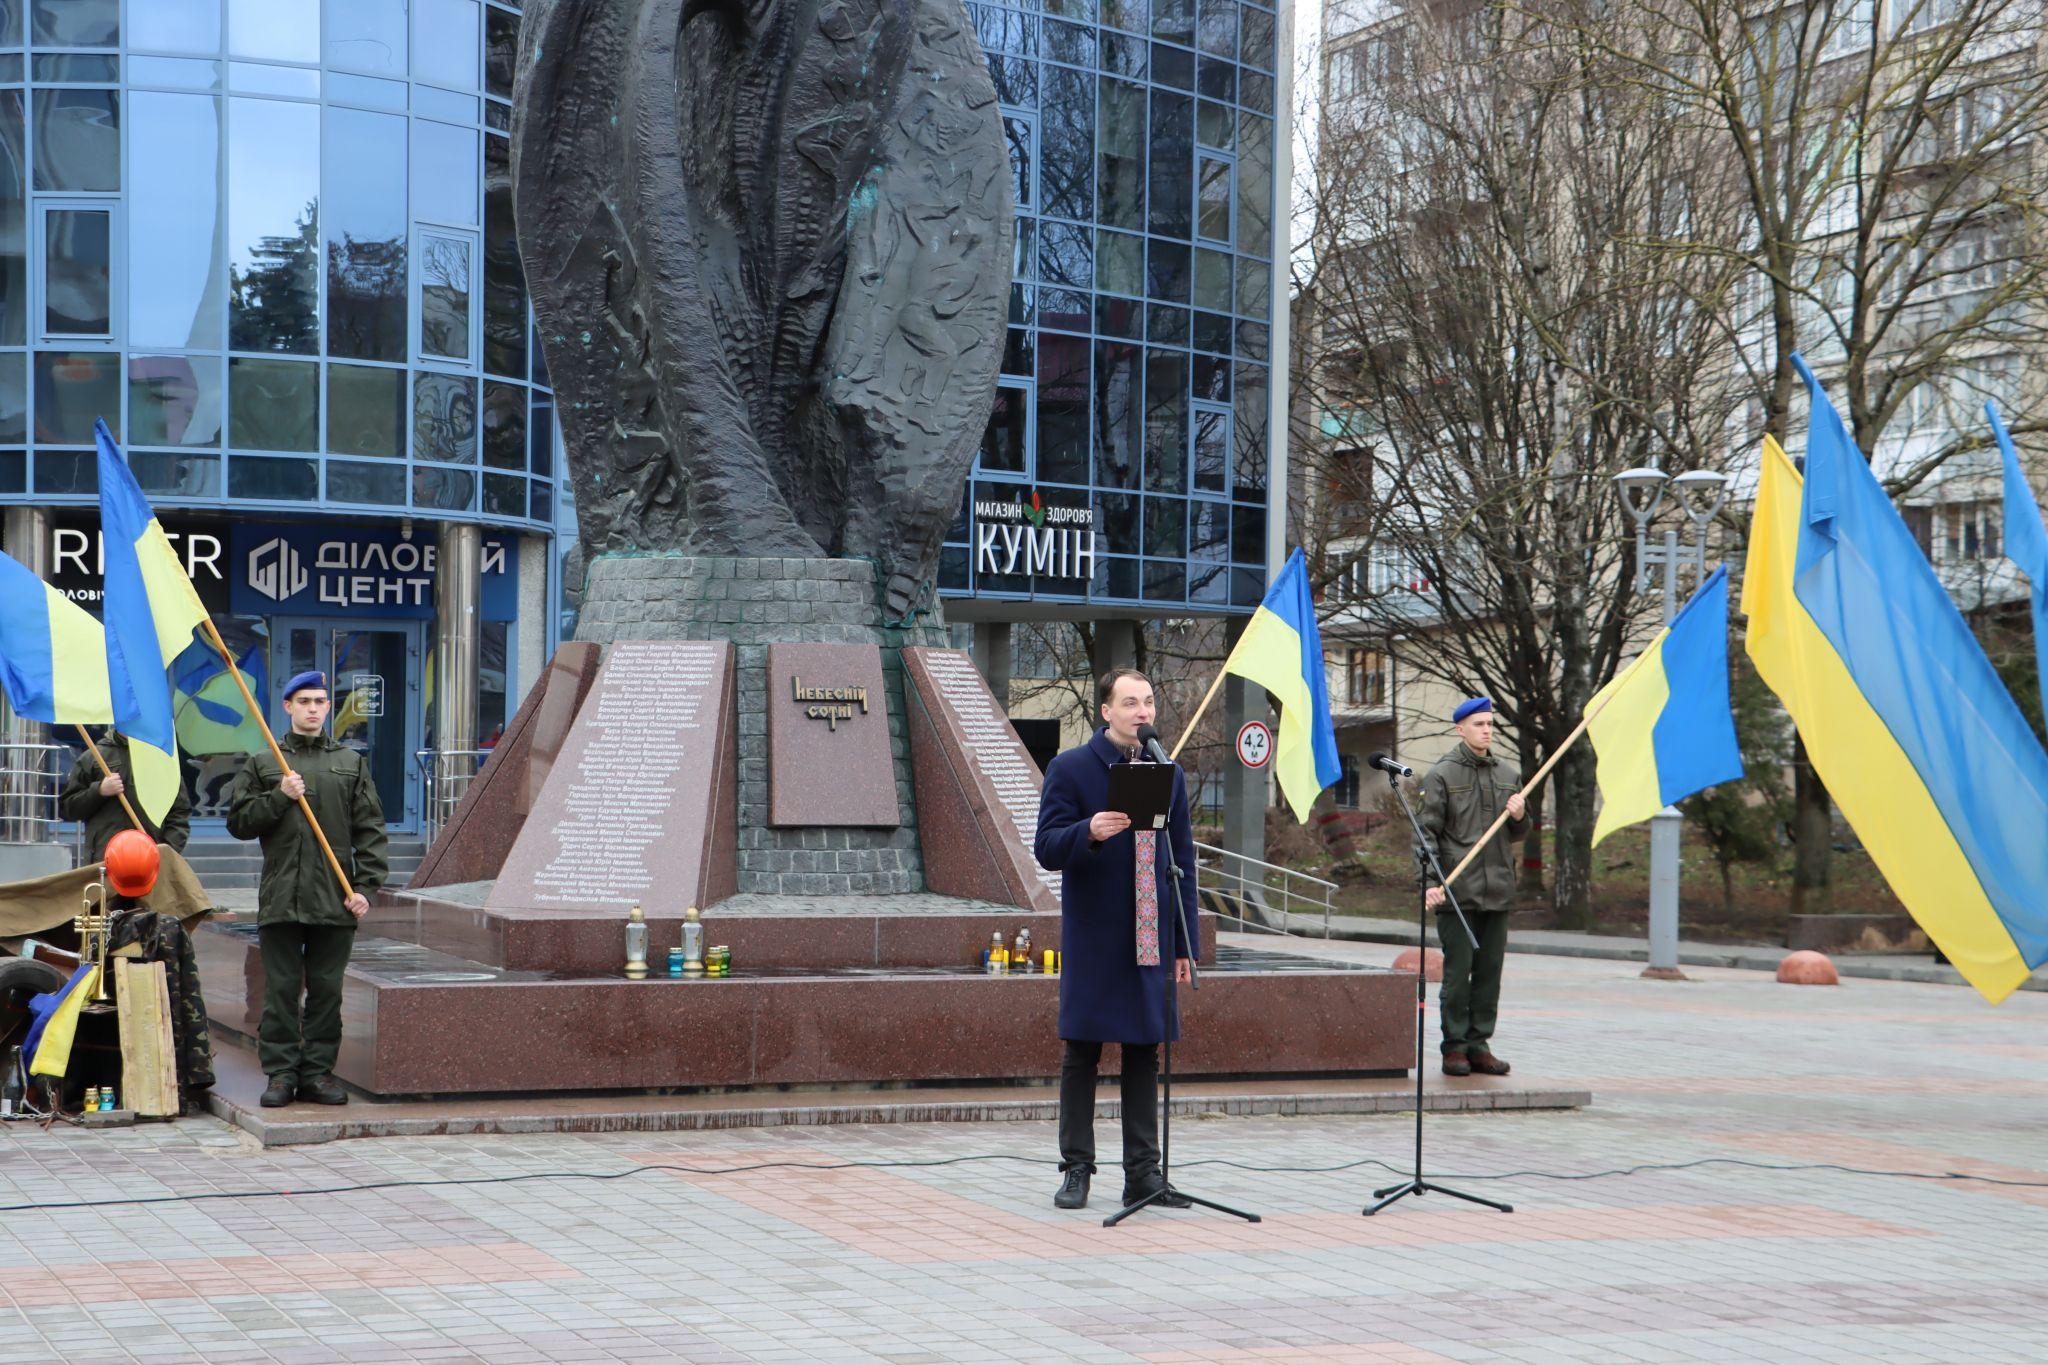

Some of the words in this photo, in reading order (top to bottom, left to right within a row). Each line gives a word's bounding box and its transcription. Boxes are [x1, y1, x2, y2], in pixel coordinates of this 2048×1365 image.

[975, 501, 1022, 518] МАГАЗИН
[1047, 506, 1093, 523] ЗДОРОВ'Я
[315, 541, 505, 574] ДІЛОВЙ
[977, 523, 1095, 580] КУМІН
[319, 575, 431, 607] ЦЕНТ
[808, 703, 852, 730] СОТНІ
